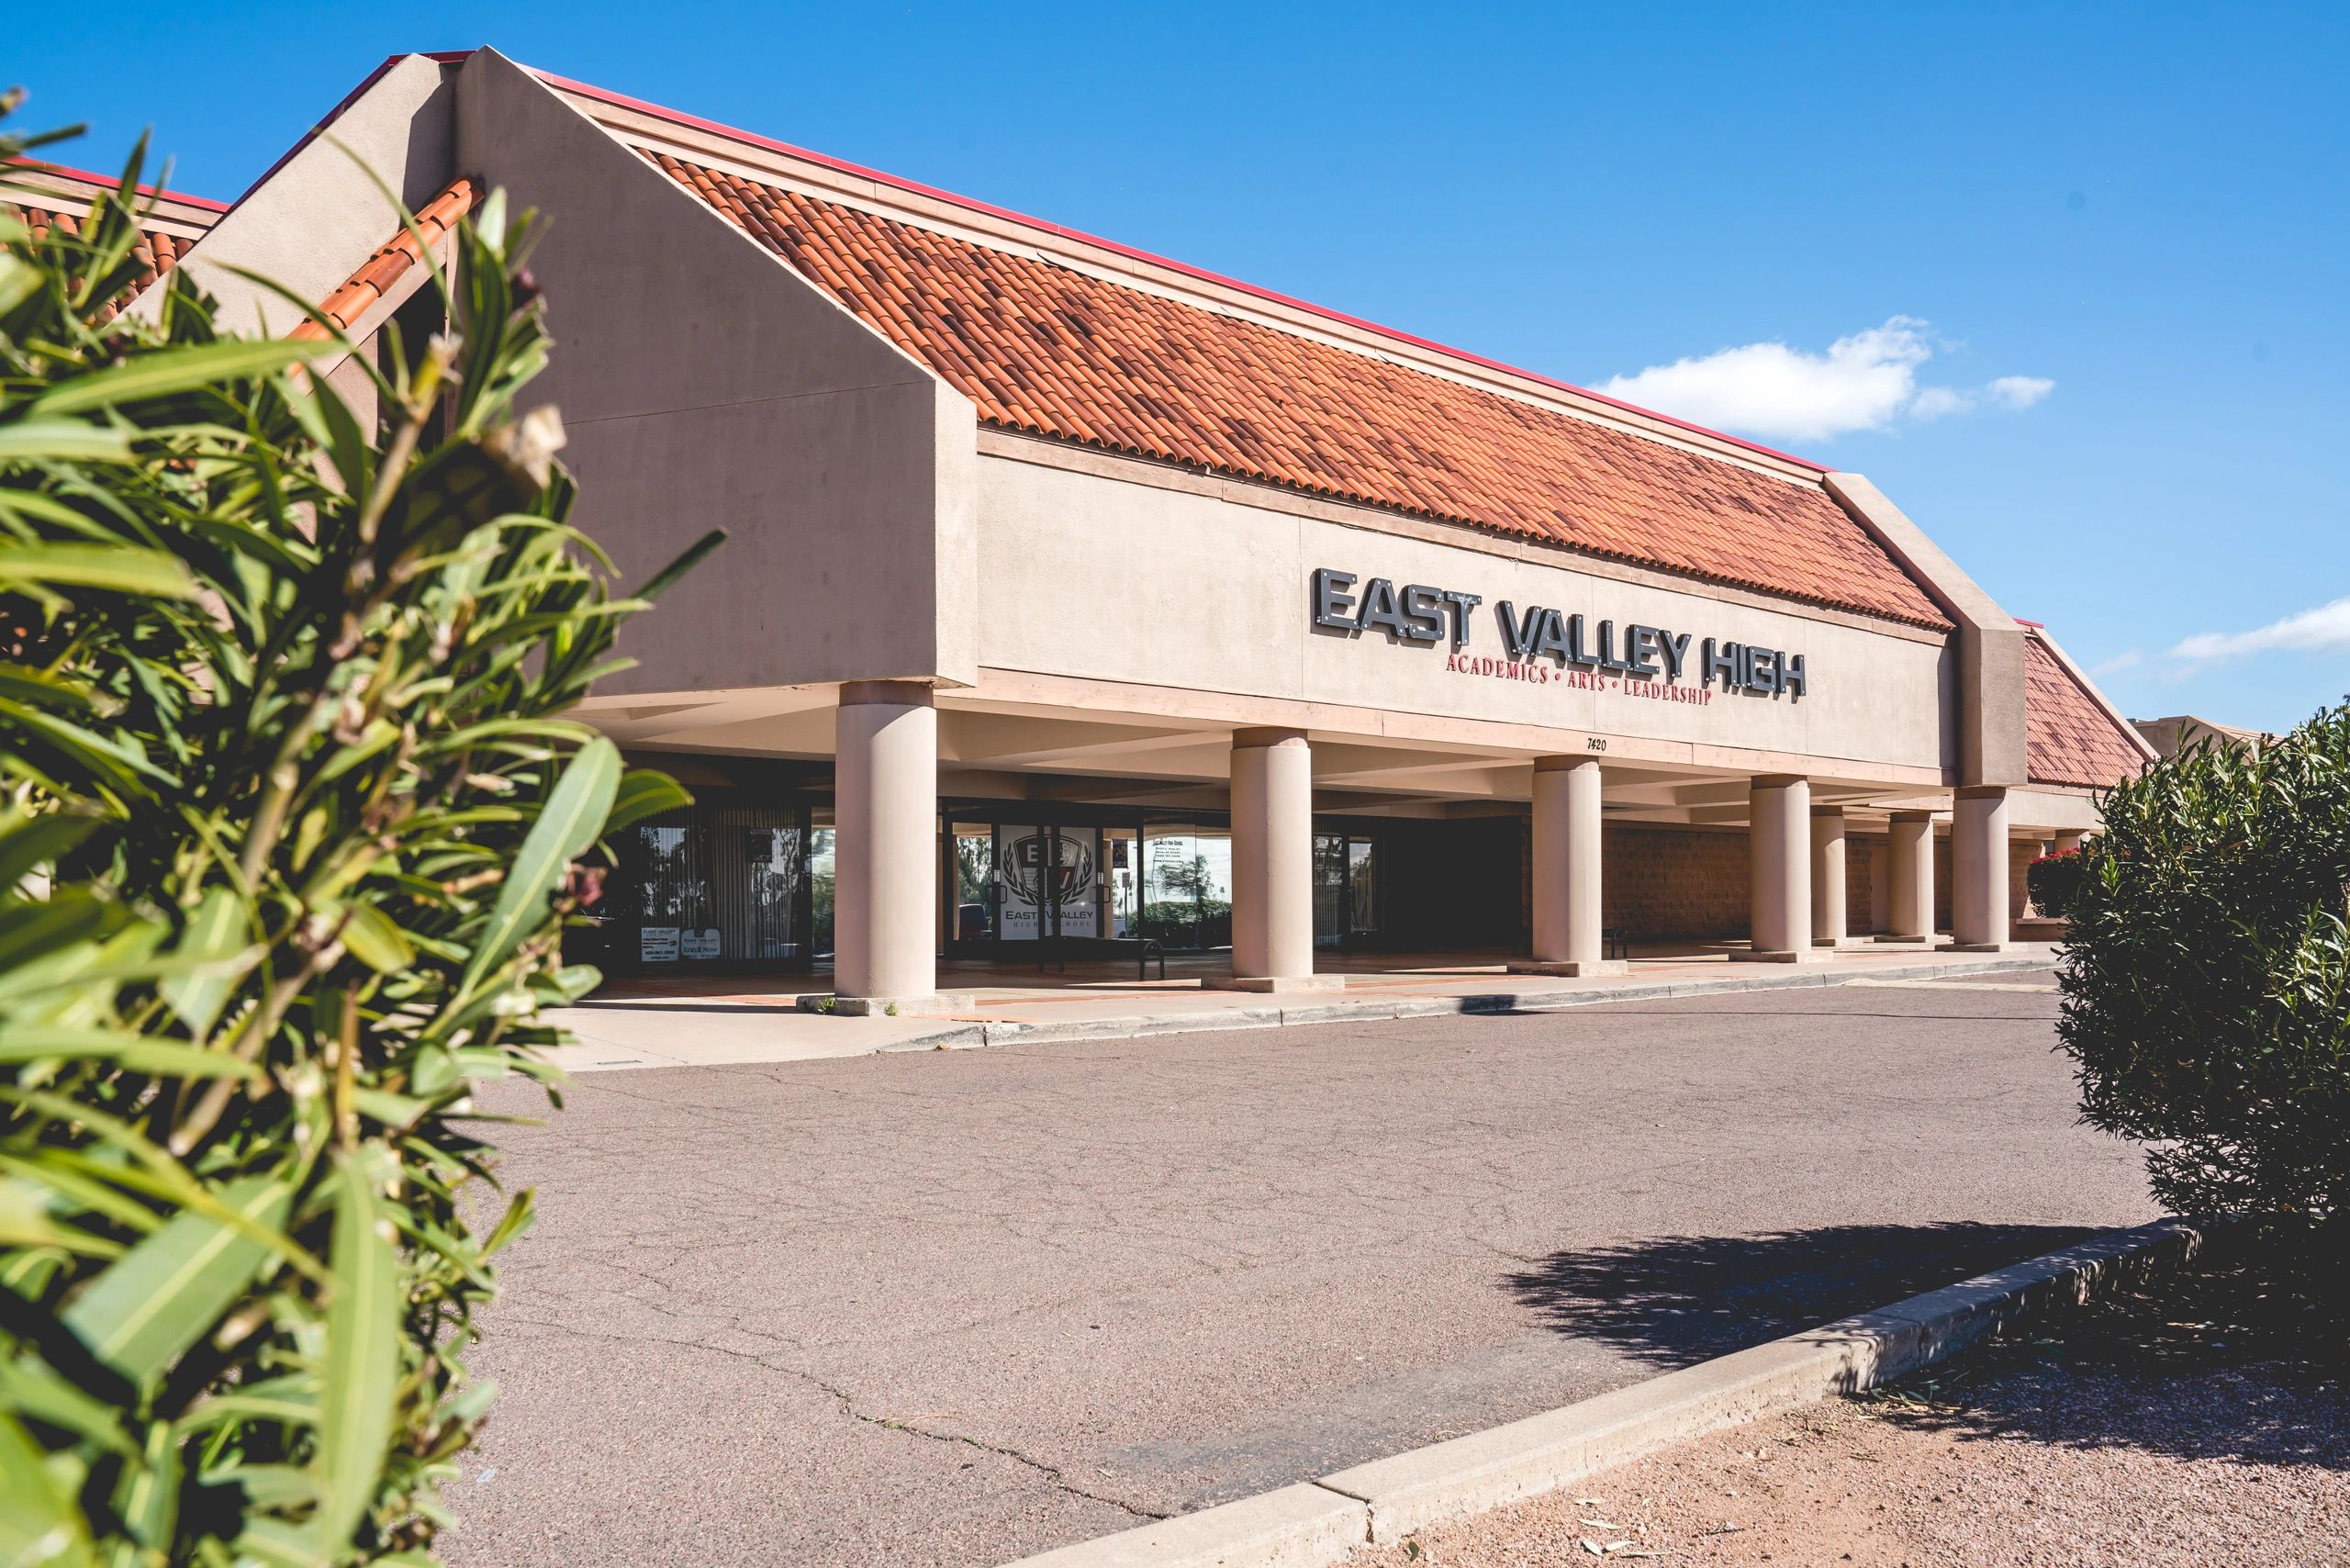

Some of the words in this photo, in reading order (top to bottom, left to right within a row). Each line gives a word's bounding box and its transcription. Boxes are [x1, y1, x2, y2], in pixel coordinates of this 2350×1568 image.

[1315, 568, 1482, 645] EAST
[1497, 600, 1692, 678] VALLEY
[1704, 637, 1806, 696] HIGH
[1446, 653, 1549, 684] ACADEMICS
[1568, 671, 1606, 691] ARTS
[1624, 678, 1712, 705] LEADERSHIP
[1587, 738, 1606, 752] 7420
[1005, 911, 1037, 920] EAST
[1046, 911, 1093, 919] VALLEY
